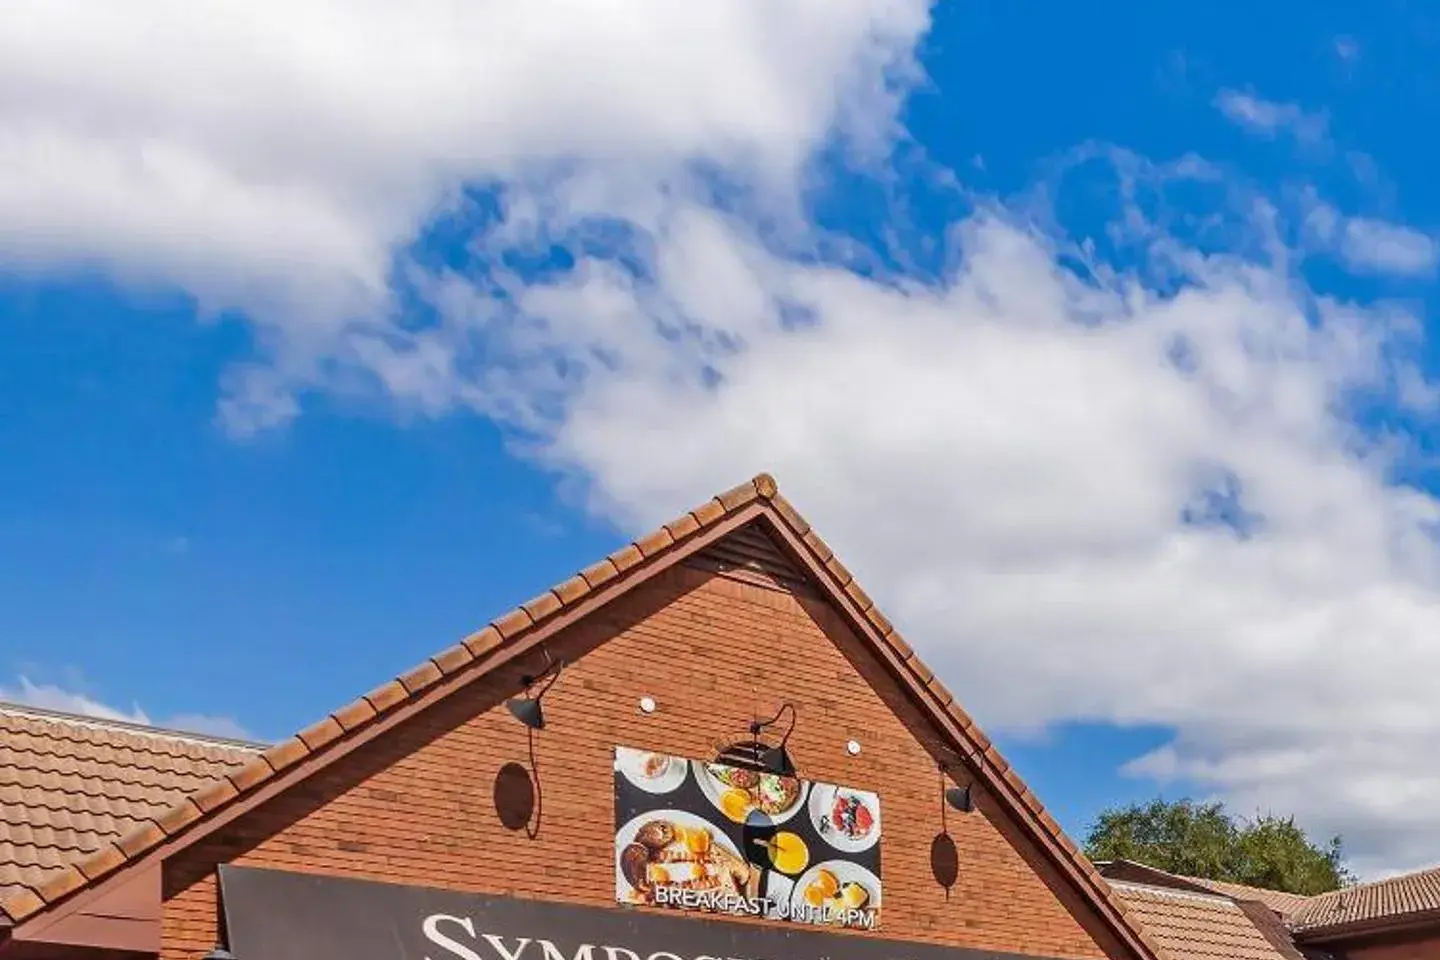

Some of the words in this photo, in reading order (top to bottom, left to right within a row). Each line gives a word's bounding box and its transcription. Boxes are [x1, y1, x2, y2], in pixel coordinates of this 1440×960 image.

[655, 886, 773, 915] BREAKFAST
[777, 902, 830, 922] UNTIL
[836, 907, 875, 928] 4PM
